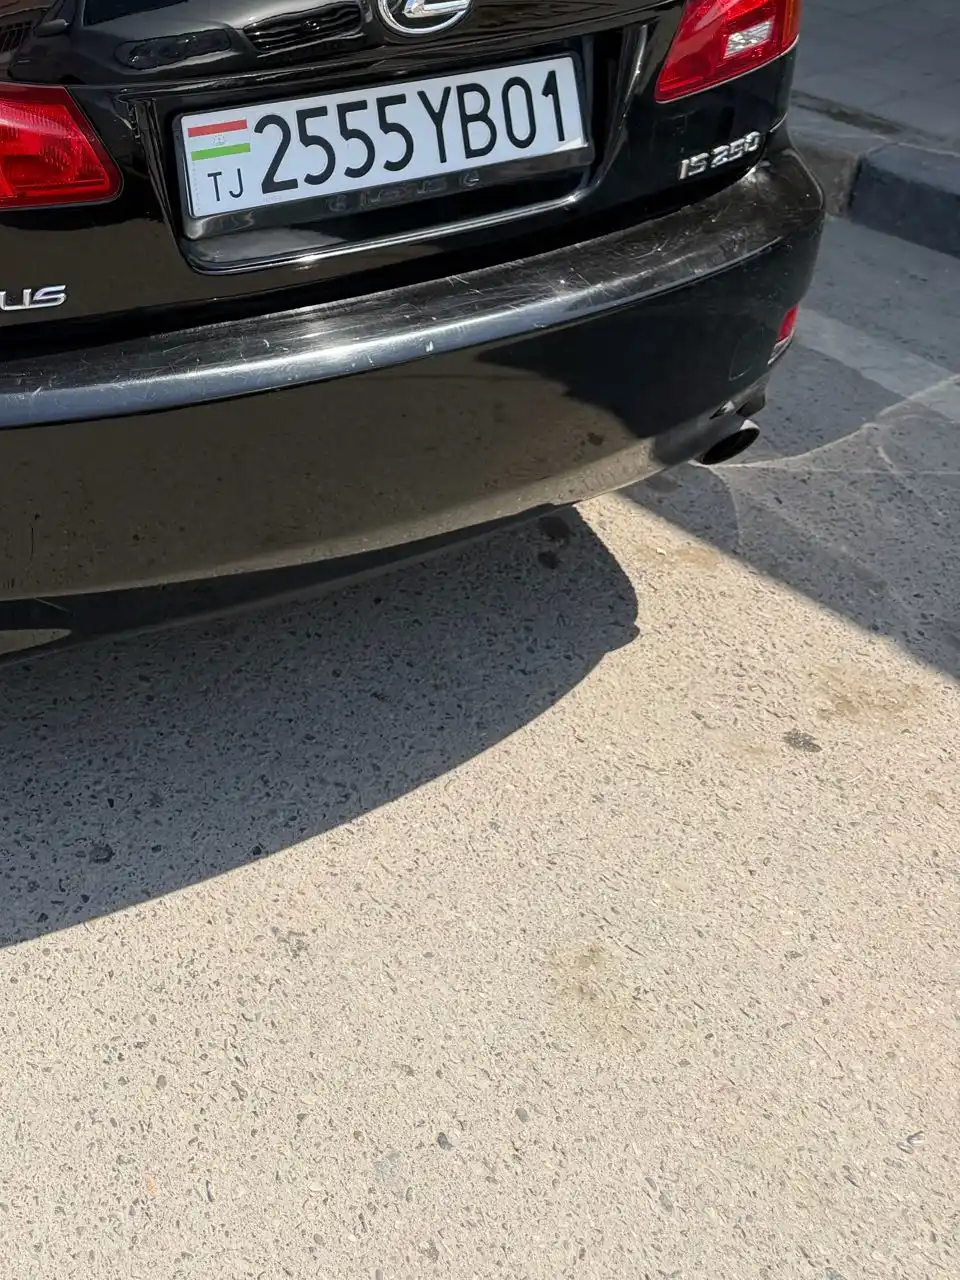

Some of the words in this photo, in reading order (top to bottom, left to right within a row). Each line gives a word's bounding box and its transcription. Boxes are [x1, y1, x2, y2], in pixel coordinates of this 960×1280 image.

[207, 168, 244, 202] TJ
[253, 70, 566, 195] 2555YB01
[679, 152, 711, 180] IS
[710, 131, 761, 168] 250
